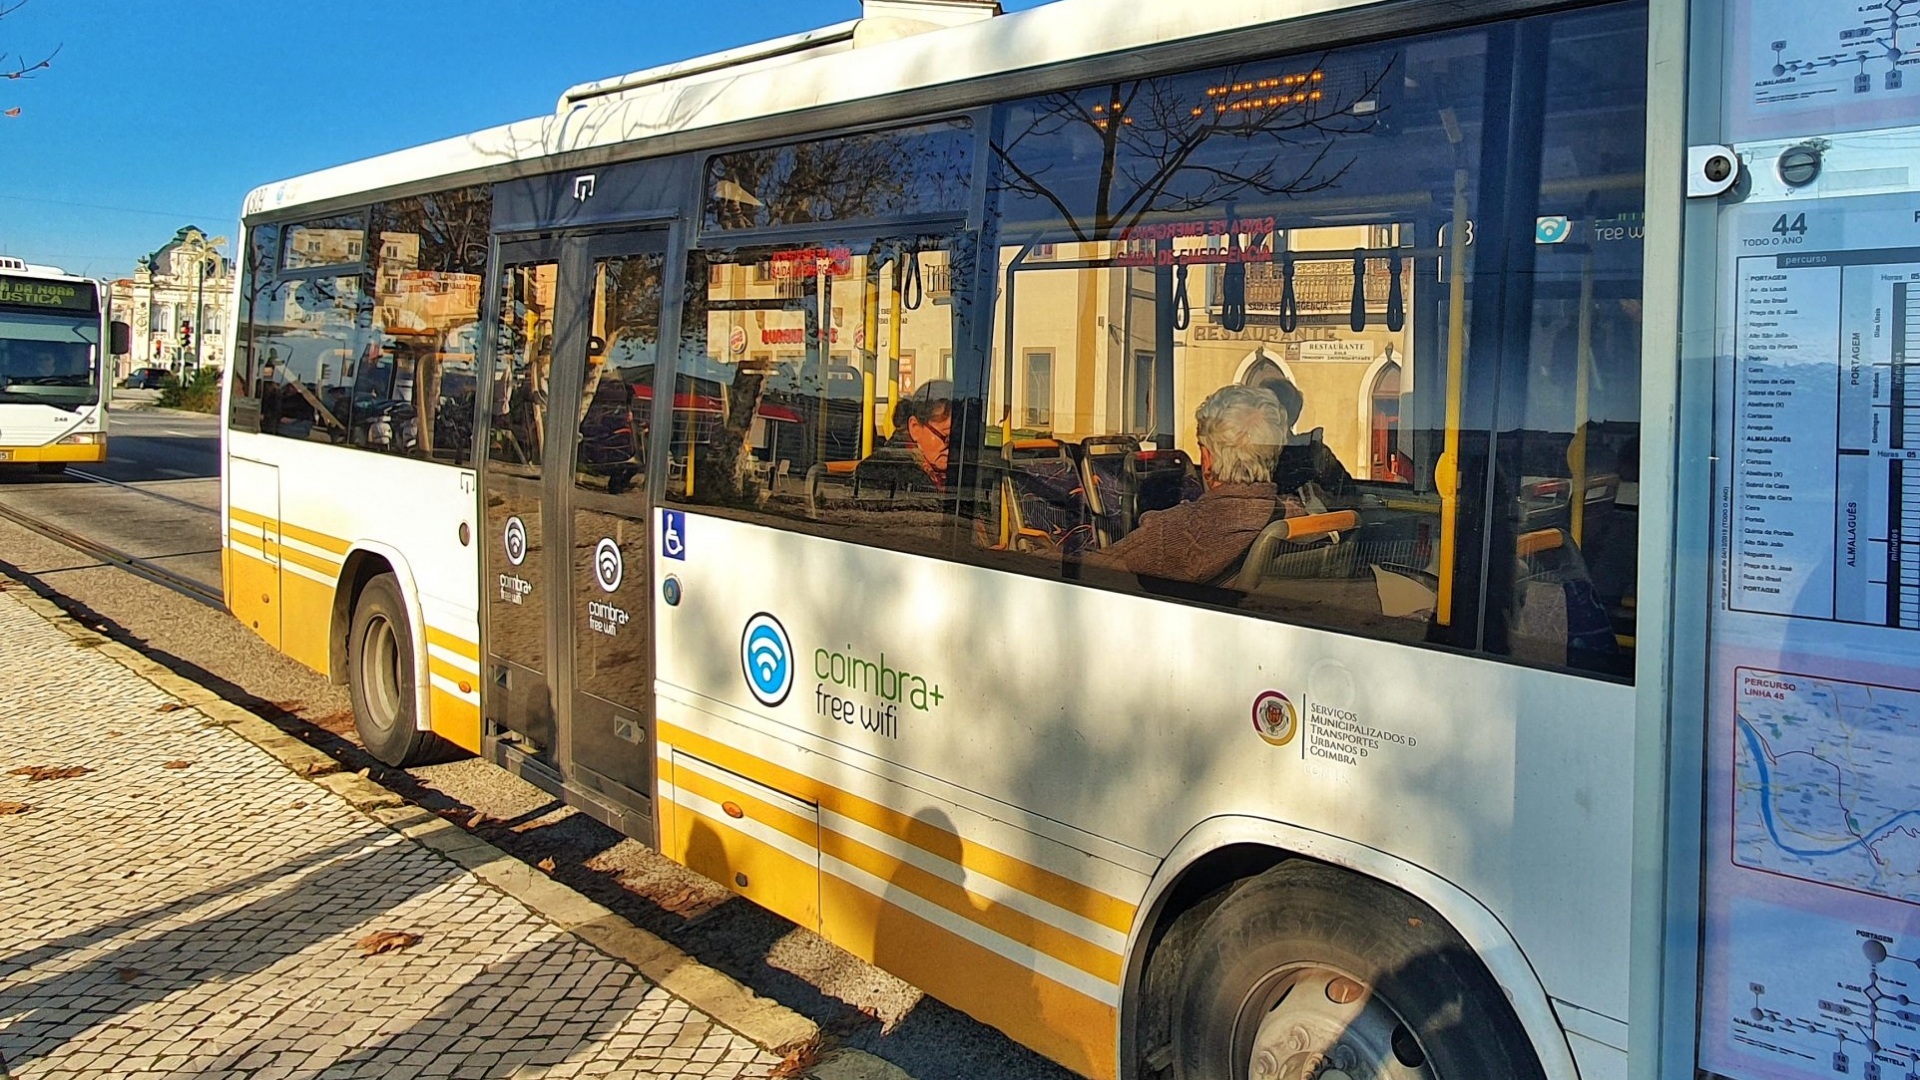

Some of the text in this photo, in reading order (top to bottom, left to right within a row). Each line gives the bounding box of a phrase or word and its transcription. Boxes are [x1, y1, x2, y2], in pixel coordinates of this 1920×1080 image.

[1772, 212, 1808, 236] 44
[1782, 237, 1803, 245] ANO
[1158, 250, 1174, 265] DE
[1785, 256, 1827, 265] percurso
[0, 291, 62, 304] USTICA
[1194, 326, 1338, 342] RESTAURANTE
[1851, 332, 1860, 385] PORTAGEM
[1846, 502, 1857, 567] ALMALAGUÊS
[500, 573, 533, 594] coimbra+
[500, 588, 522, 605] free wifi
[589, 599, 630, 625] coimbra+
[589, 615, 617, 637] free wifi
[815, 644, 944, 711] coimbra+
[1745, 678, 1796, 691] PERCURSO
[1745, 689, 1772, 698] LINHA
[815, 683, 897, 739] free wifi
[1311, 702, 1358, 722] SERVIÇOS
[1310, 714, 1405, 744] MUNICIPALIZADOS
[1311, 724, 1378, 749] TRANSPORTES
[1310, 735, 1357, 755] URBANOS
[1310, 746, 1357, 765] COIMBRA
[1856, 930, 1894, 943] PORTAGEM
[1874, 1054, 1906, 1067] PORTELA
